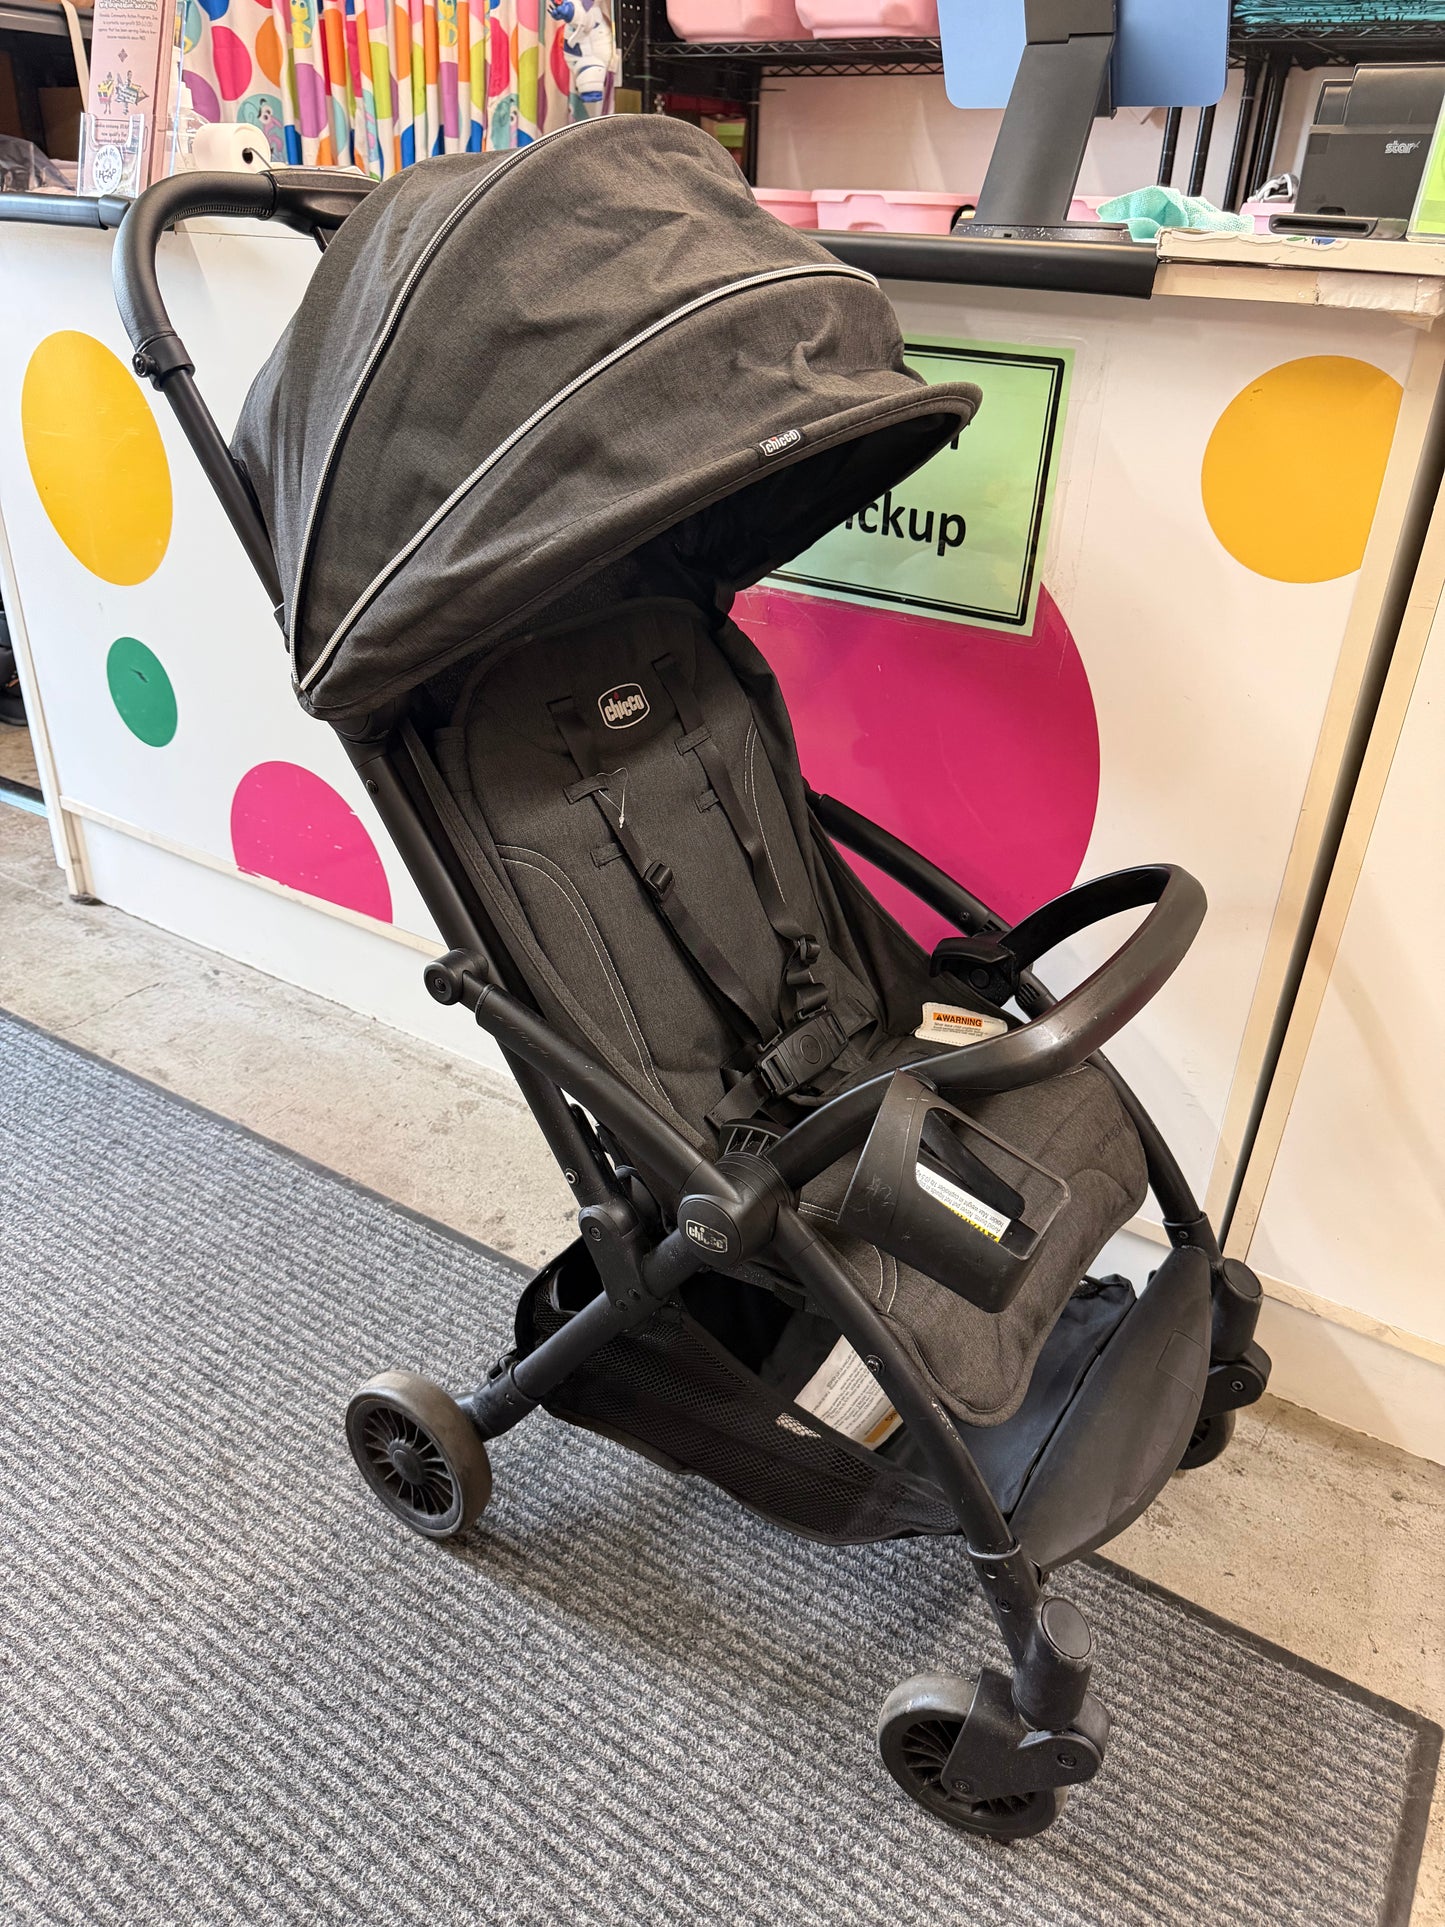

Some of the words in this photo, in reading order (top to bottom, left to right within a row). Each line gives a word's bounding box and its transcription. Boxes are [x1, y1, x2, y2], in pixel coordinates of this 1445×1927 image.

[765, 430, 798, 453] chicco
[604, 691, 645, 722] chicco
[942, 1014, 982, 1027] WARNING
